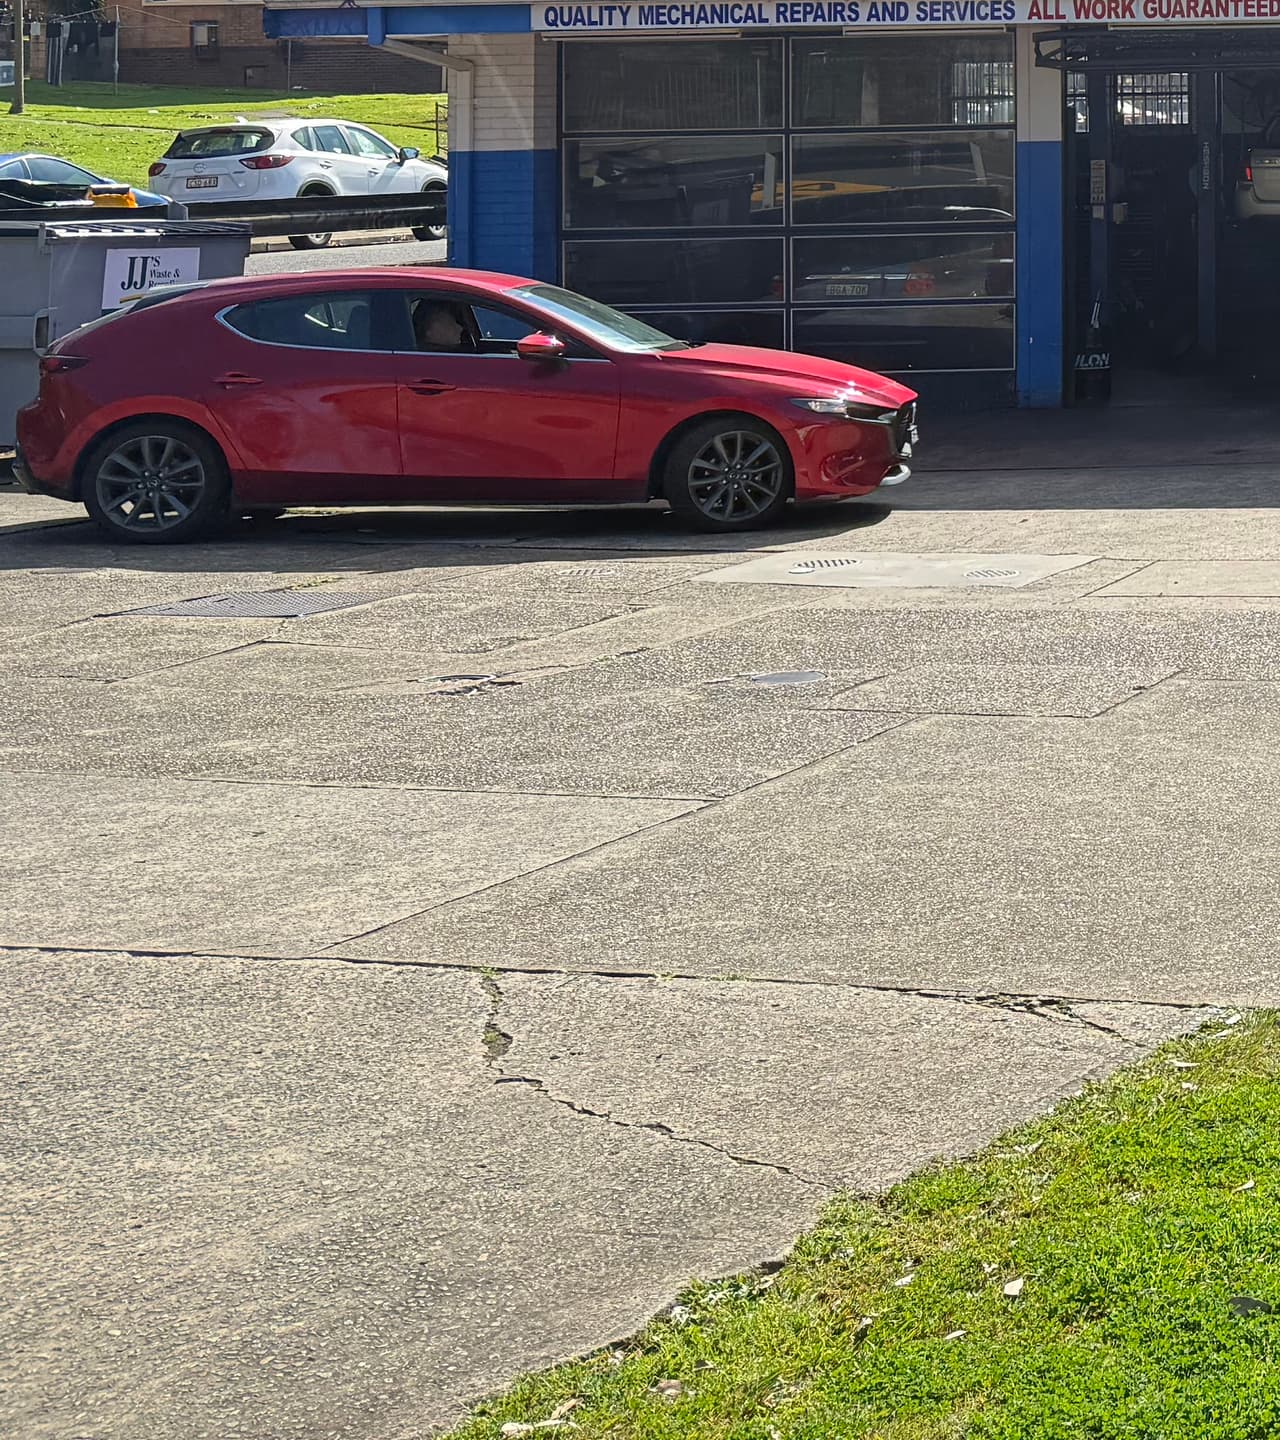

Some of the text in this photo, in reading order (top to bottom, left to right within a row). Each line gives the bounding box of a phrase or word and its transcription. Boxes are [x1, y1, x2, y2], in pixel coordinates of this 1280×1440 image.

[544, 4, 631, 27] QUALITY
[638, 3, 768, 26] MECHANICAL
[776, 1, 859, 23] REPAIRS
[867, 1, 908, 22] AND
[916, 0, 1015, 21] SERVICES
[1027, 0, 1066, 21] ALL
[150, 270, 172, 279] Waste
